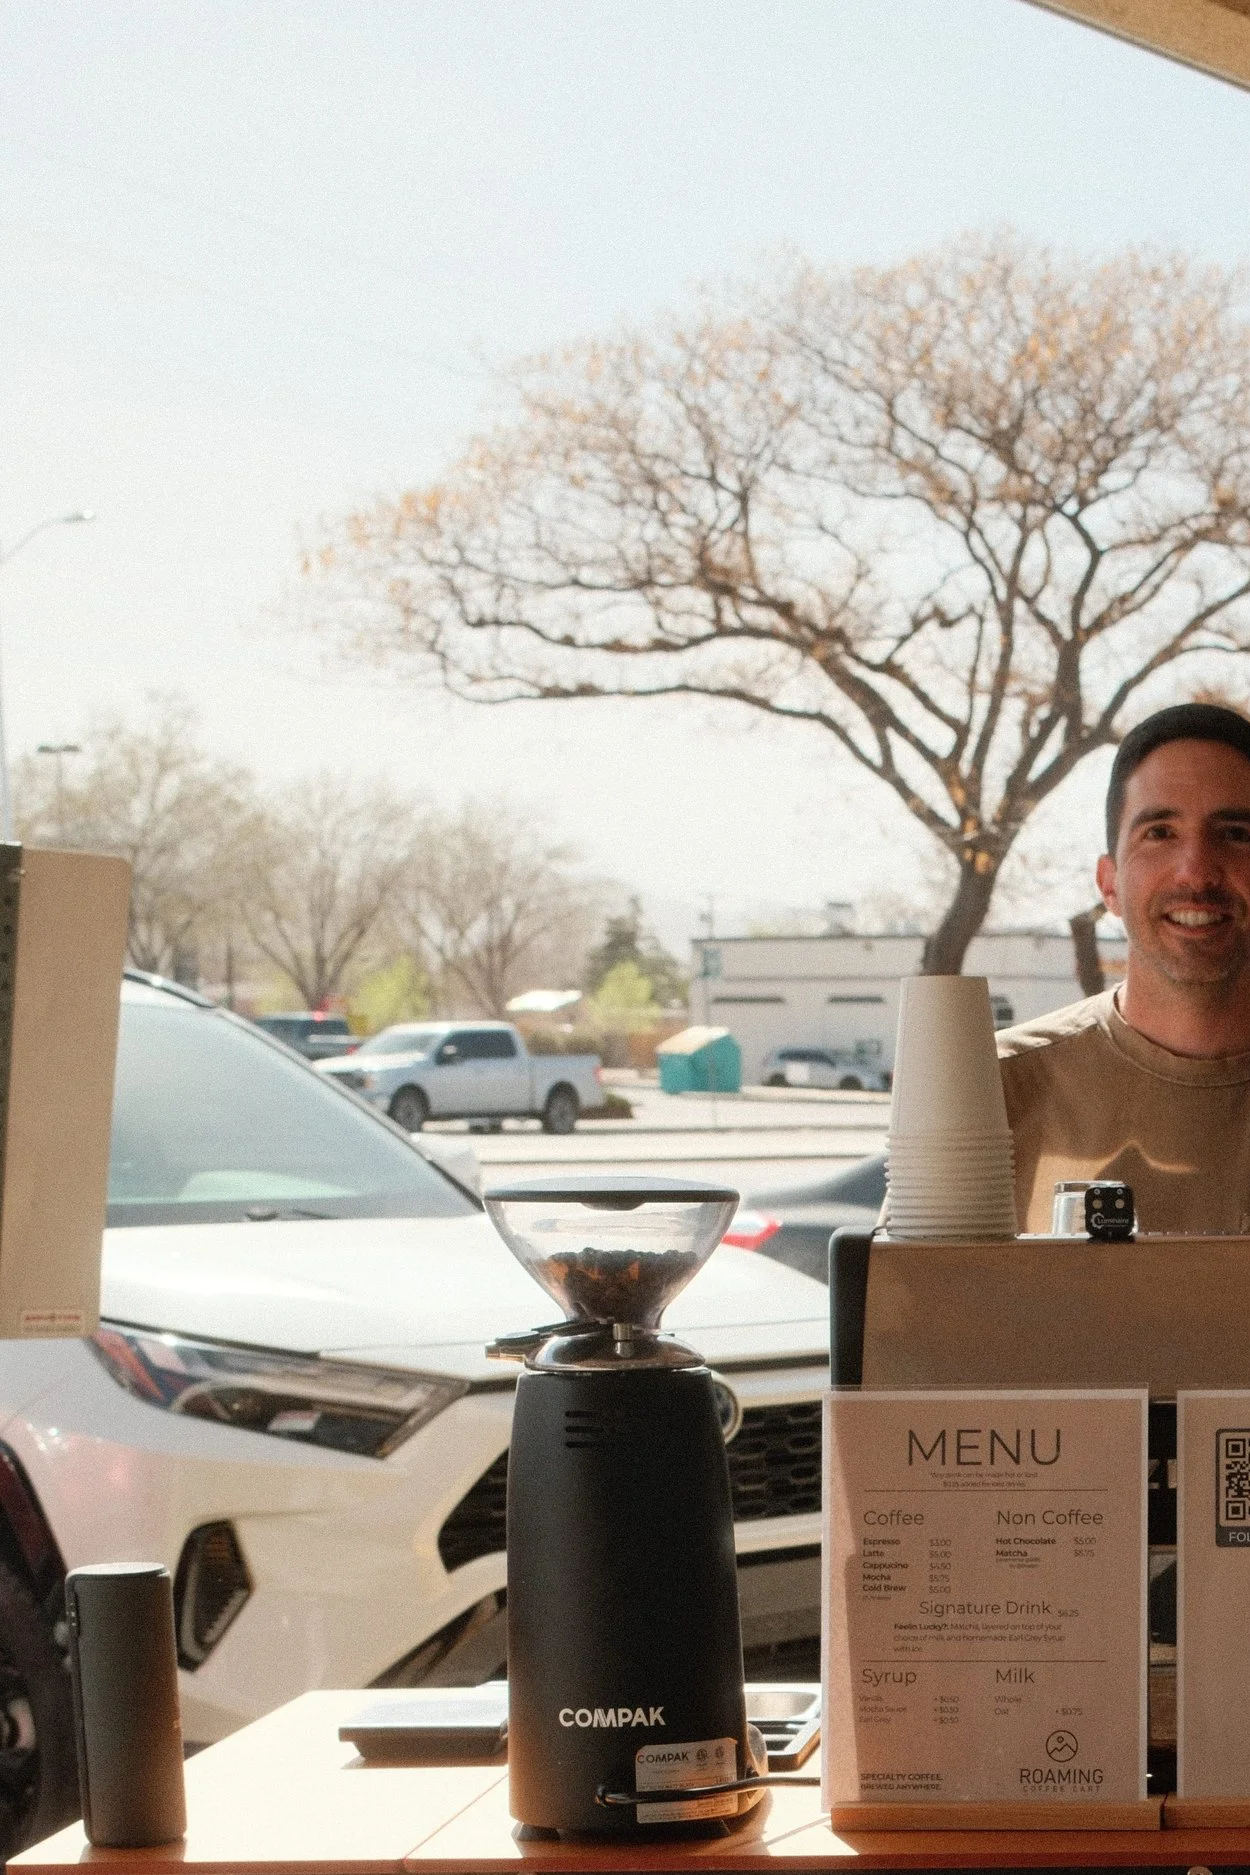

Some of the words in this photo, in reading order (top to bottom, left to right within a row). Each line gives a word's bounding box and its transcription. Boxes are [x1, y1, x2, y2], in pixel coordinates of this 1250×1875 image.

[908, 1428, 1061, 1466] MENU
[863, 1510, 924, 1526] Coffee
[997, 1510, 1036, 1525] Non
[1042, 1509, 1104, 1525] Coffee
[863, 1538, 901, 1547] Espresso
[1013, 1537, 1056, 1545] Chocolate
[863, 1550, 885, 1558] Latte
[996, 1549, 1028, 1557] Matcha
[862, 1573, 892, 1581] Mocha
[862, 1584, 882, 1592] Cold
[884, 1584, 907, 1592] Brew
[919, 1601, 1001, 1618] Signature
[1006, 1601, 1051, 1615] Drink
[862, 1668, 917, 1687] Syrup
[996, 1668, 1035, 1683] Milk
[559, 1706, 666, 1728] COMPAK
[637, 1751, 690, 1764] COMPAK
[860, 1773, 906, 1781] SPECIALTY
[1020, 1769, 1104, 1785] ROAMING
[1023, 1785, 1065, 1793] COFFEE
[1073, 1785, 1101, 1793] CART
